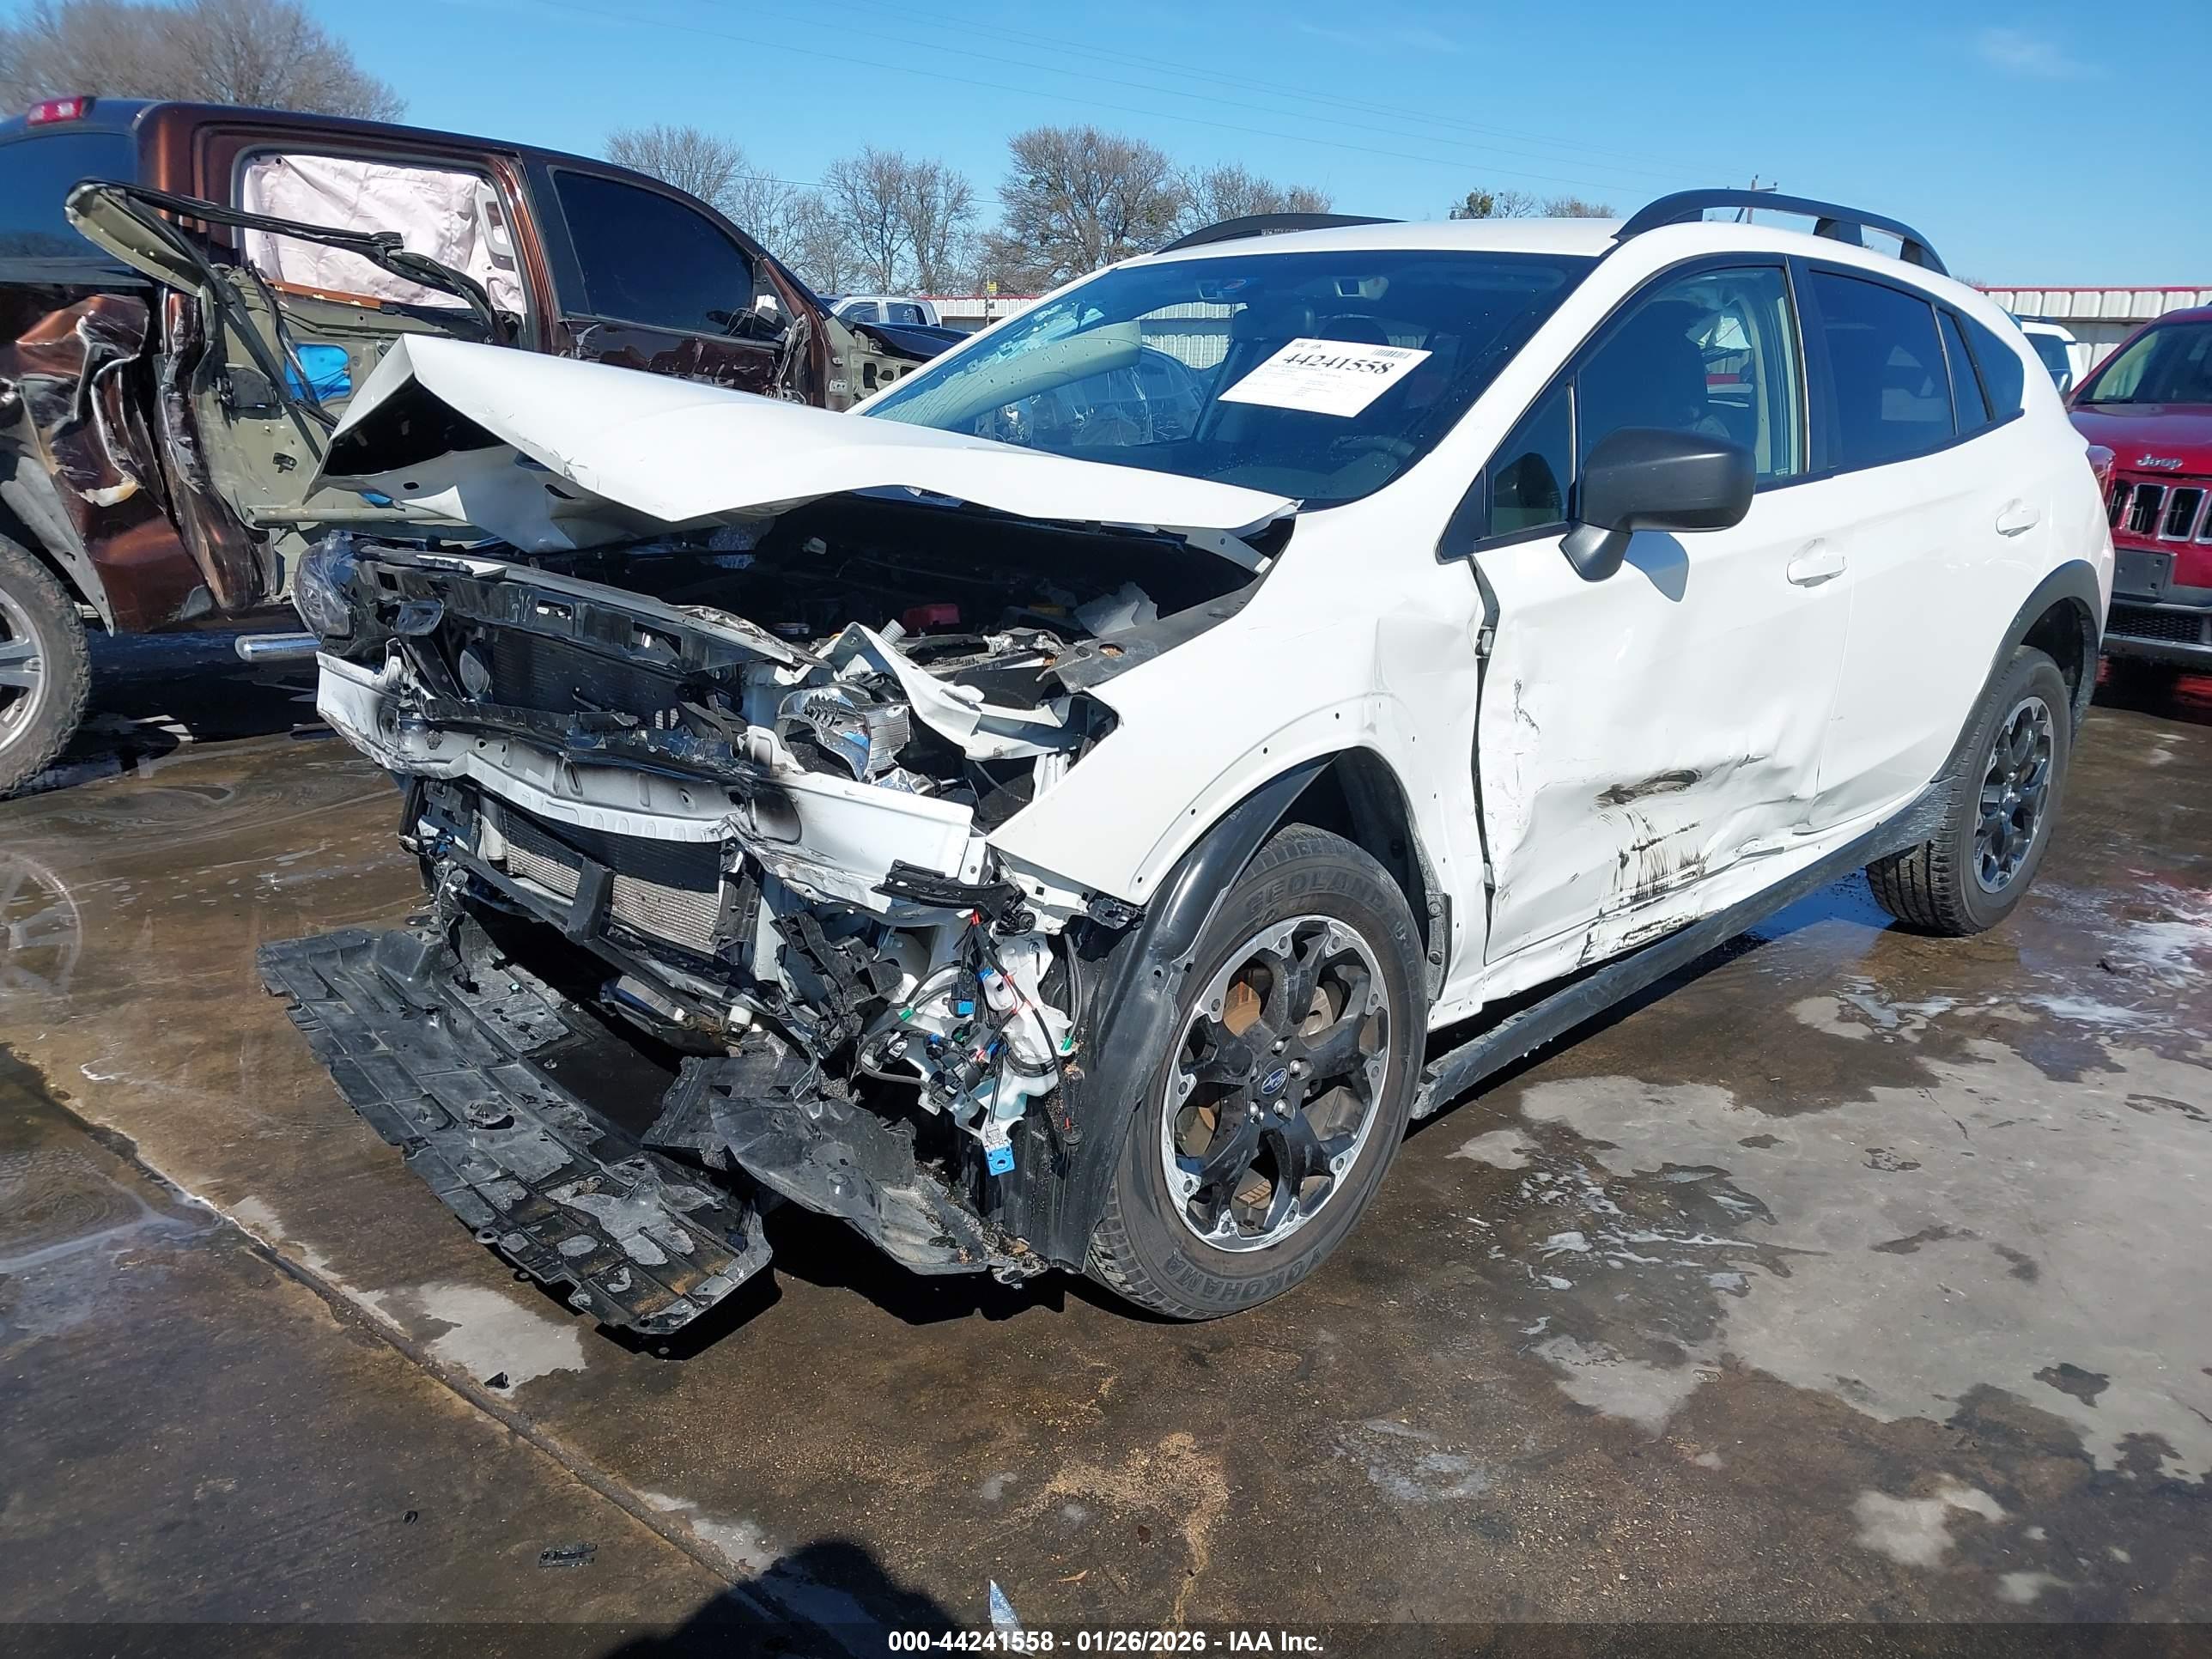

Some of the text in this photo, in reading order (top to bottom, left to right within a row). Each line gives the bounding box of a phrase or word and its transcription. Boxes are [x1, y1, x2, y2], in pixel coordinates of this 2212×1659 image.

[1284, 353, 1395, 374] 44241558
[2136, 453, 2184, 471] Jeep
[1164, 1249, 1322, 1304] YOKOHAMA
